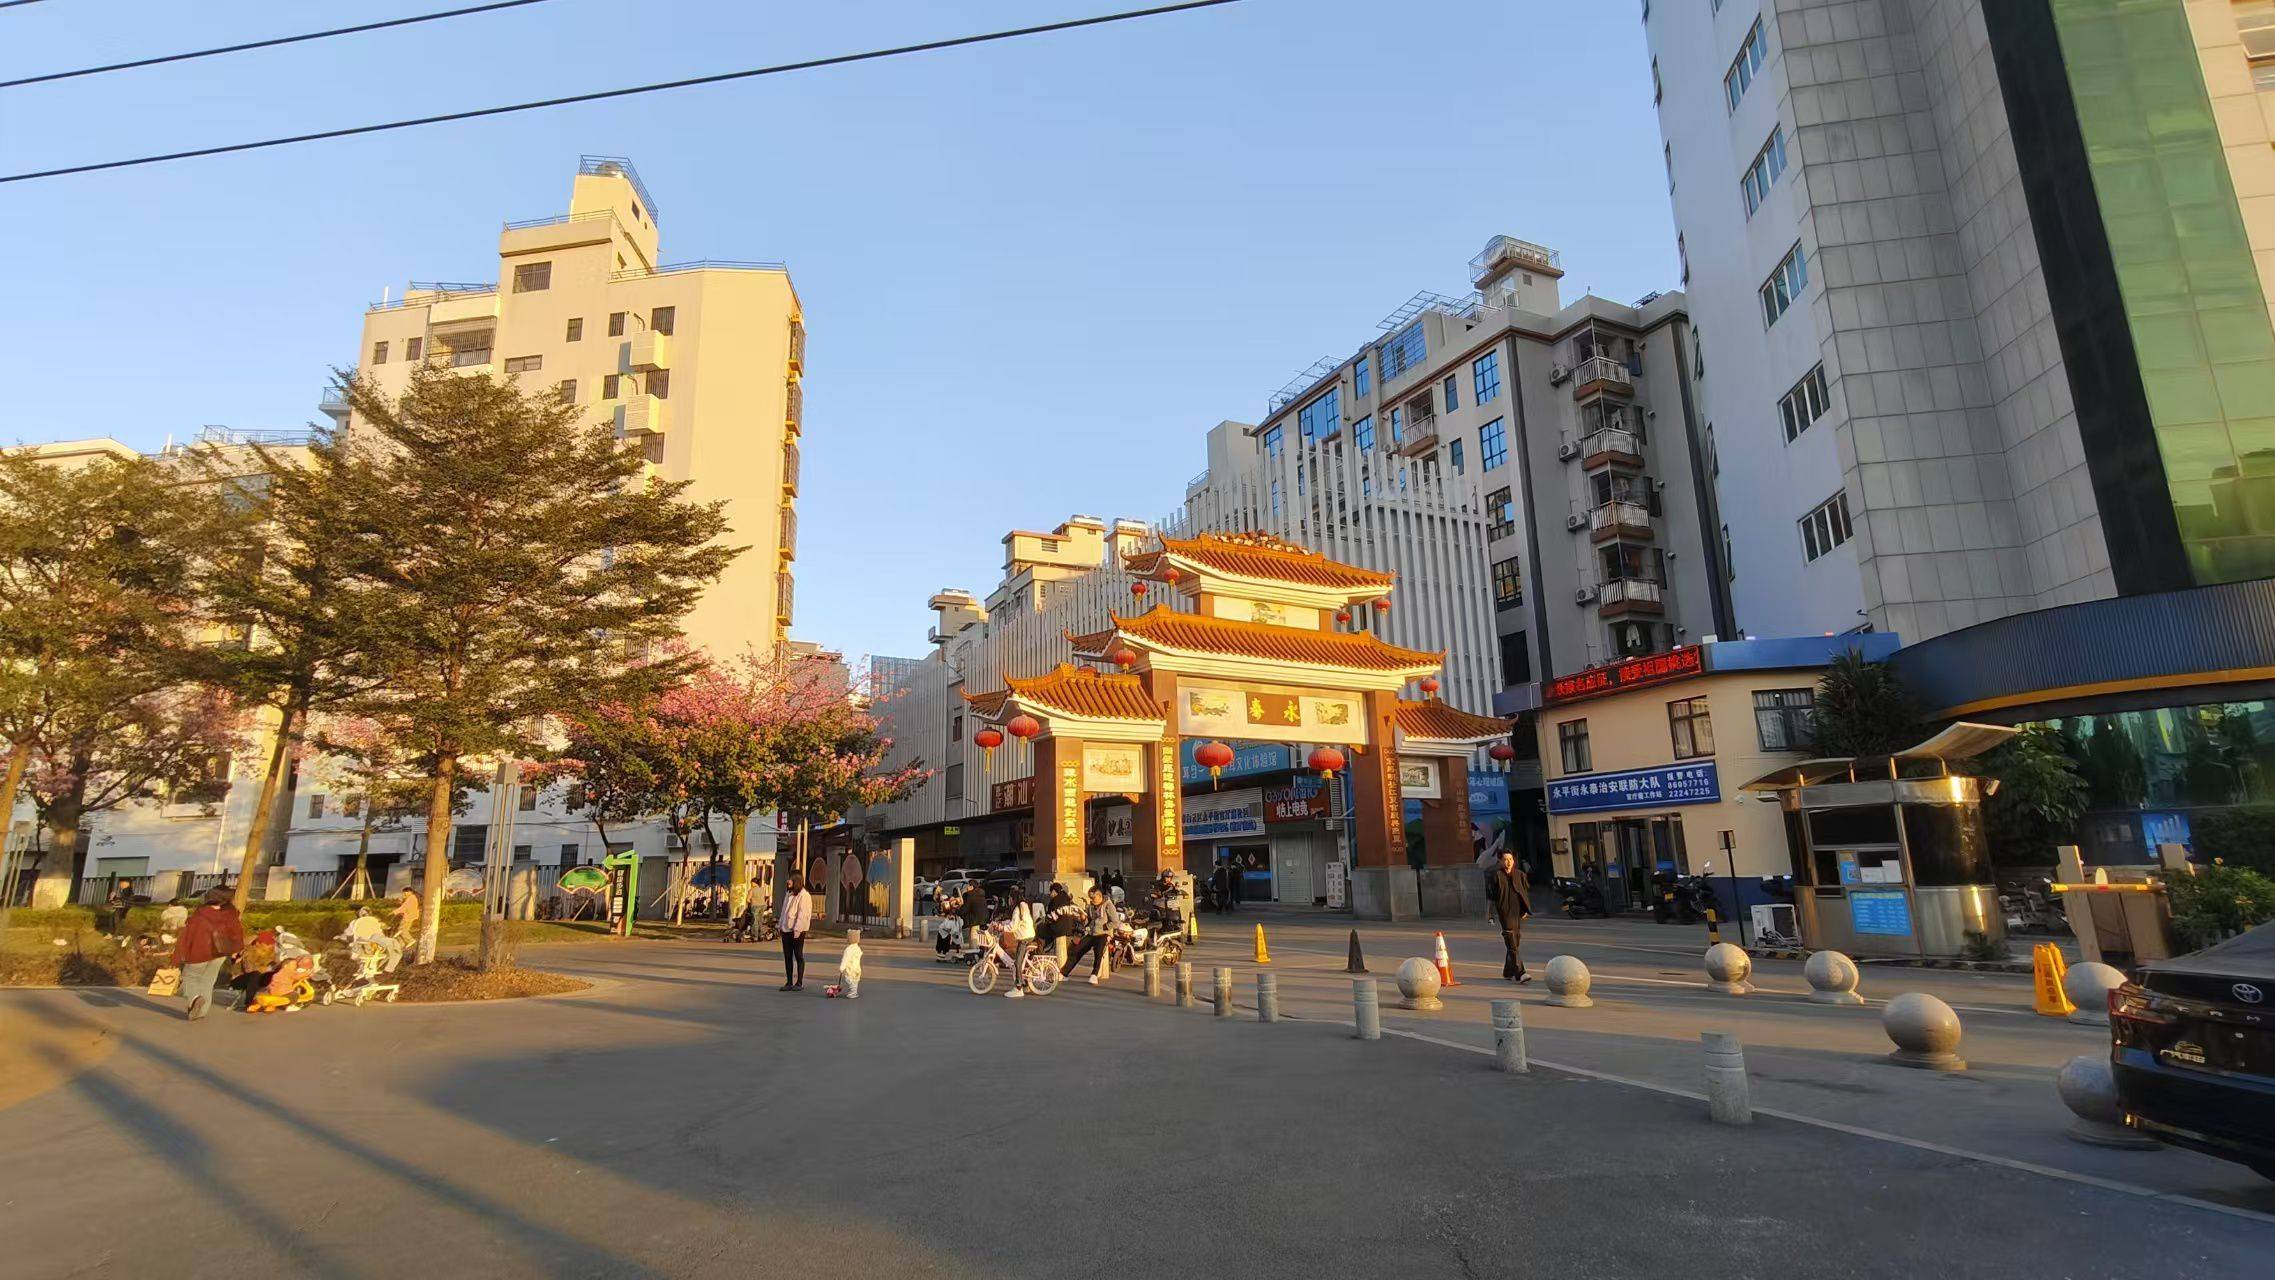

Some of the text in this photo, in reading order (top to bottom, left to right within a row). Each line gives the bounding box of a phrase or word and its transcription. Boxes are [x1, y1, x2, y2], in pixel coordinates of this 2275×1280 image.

[1552, 776, 1660, 798] 永平街永泰治安联防大队
